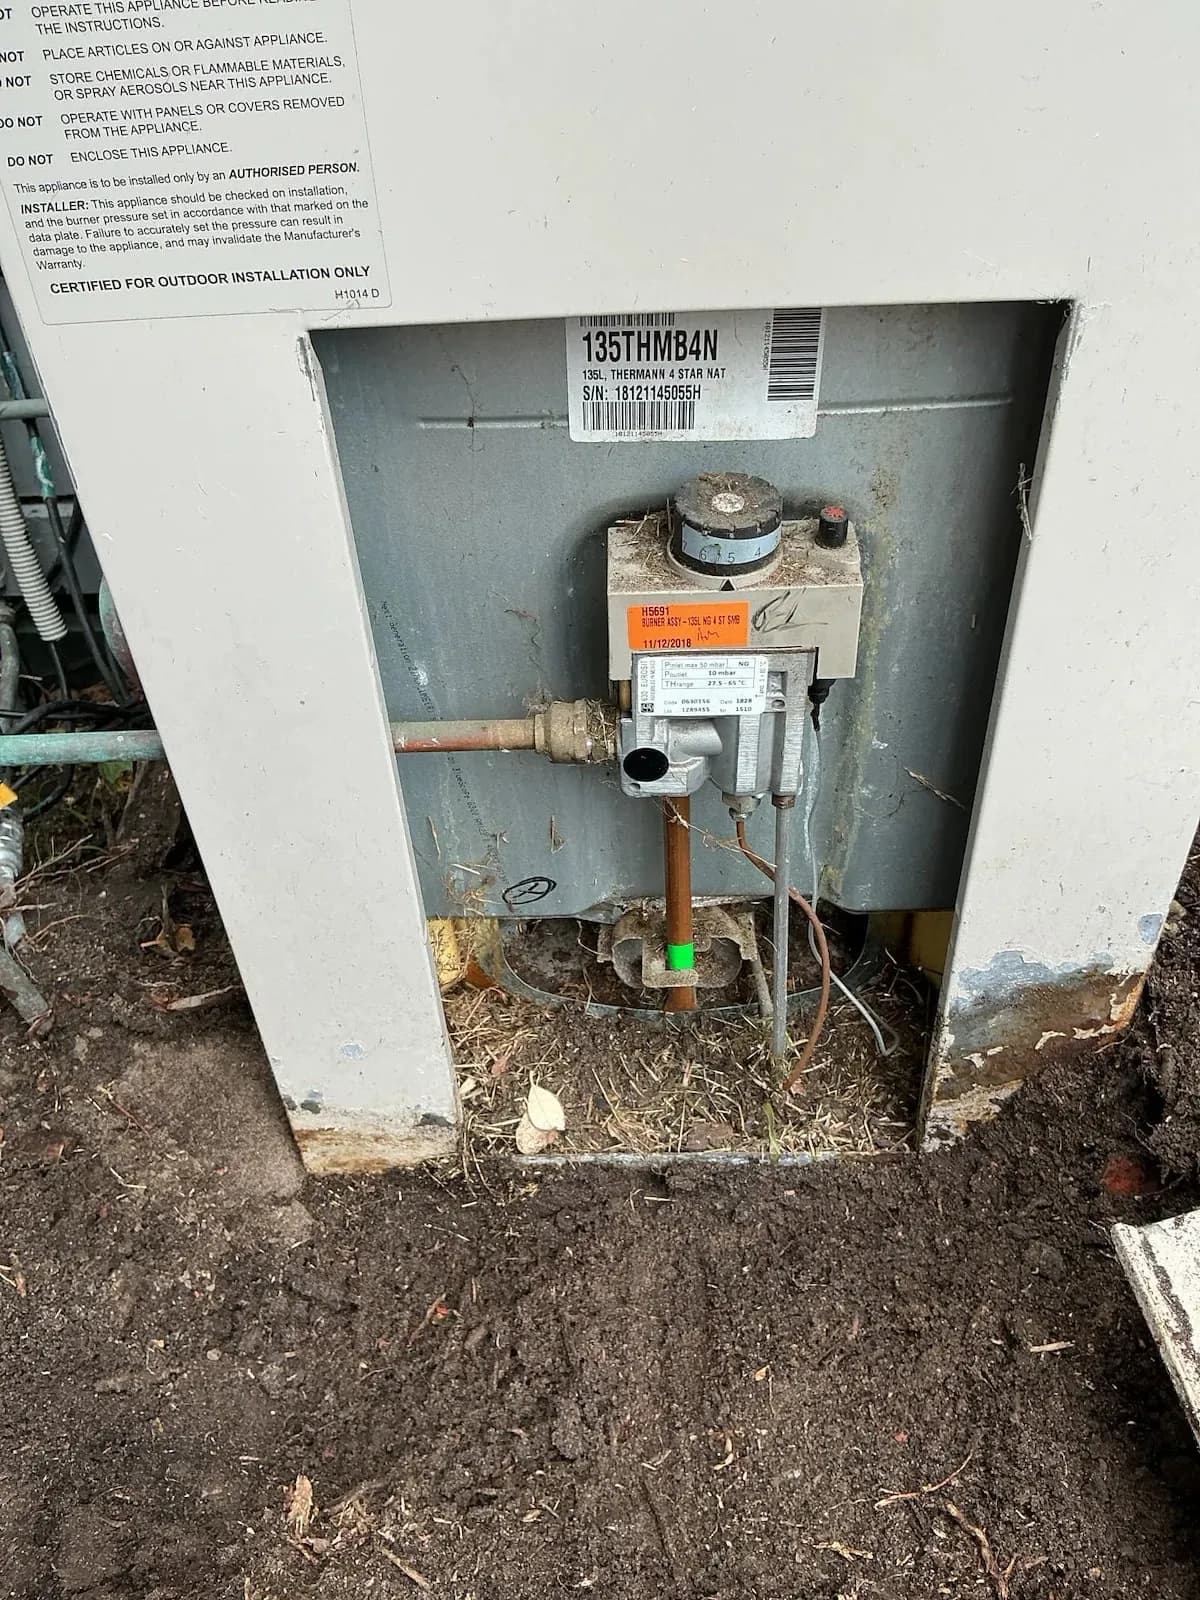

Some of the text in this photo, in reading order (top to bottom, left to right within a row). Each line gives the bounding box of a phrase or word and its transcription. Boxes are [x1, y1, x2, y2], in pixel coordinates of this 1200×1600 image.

[31, 3, 93, 18] OPERATE
[94, 1, 125, 14] THIS
[128, 0, 200, 12] APPLIANCE
[35, 16, 164, 35] THE INSTRUCTIONS.
[42, 47, 85, 61] PLACE
[88, 43, 149, 58] ARTICLES
[151, 41, 171, 53] ON
[174, 40, 194, 52] OR
[196, 36, 251, 50] AGAINST
[253, 32, 328, 47] APPLIANCE.
[5, 75, 32, 88] NOT
[49, 71, 93, 85] STORE
[95, 66, 171, 82] CHEMICALS
[171, 65, 191, 77] OR
[193, 60, 270, 75] FLAMMABLE
[54, 72, 332, 101] OR SPRAY AEROSOLS NEAR THIS APPLIANCE.
[17, 115, 43, 127] NOT
[60, 110, 119, 125] OPERATE
[120, 108, 153, 120] WITH
[155, 104, 204, 118] PANELS
[206, 103, 226, 115] OR
[228, 99, 280, 113] COVERS
[283, 96, 345, 110] REMOVED
[64, 120, 202, 140] FROM THE APPLIANCE.
[7, 142, 232, 167] DO NOT ENCLOSE THIS APPLIANCE.
[13, 162, 360, 194] This appliance is to be installed only by an AUTHORISED PERSON.
[21, 185, 348, 215] INSTALLER: This appliance should be checked on installation,
[25, 199, 368, 229] and the burner pressure set in accordance with that marked on the
[29, 214, 343, 243] data plate. Failure to accurately set the pressure can result in
[33, 228, 361, 257] damage to the appliance, and may invalidate the Manufacturer's
[35, 259, 85, 270] Warranty.
[50, 265, 370, 294] CERTIFIED FOR OUTDOOR INSTALLATION ONLY
[334, 288, 380, 299] H1014 D
[582, 329, 718, 362] 135THMB4N
[582, 367, 726, 381] 135L, THERMANN 4 STAR NAT
[583, 384, 701, 401] S/N: 18121145055H
[727, 551, 736, 564] 5
[754, 546, 761, 557] 4
[641, 606, 669, 616] H5691
[641, 617, 665, 627] BURNER
[667, 616, 682, 627] ASSY
[688, 616, 701, 626] 135L
[718, 615, 726, 625] ST
[728, 615, 741, 625] SMB
[643, 638, 692, 649] 11/12/2018
